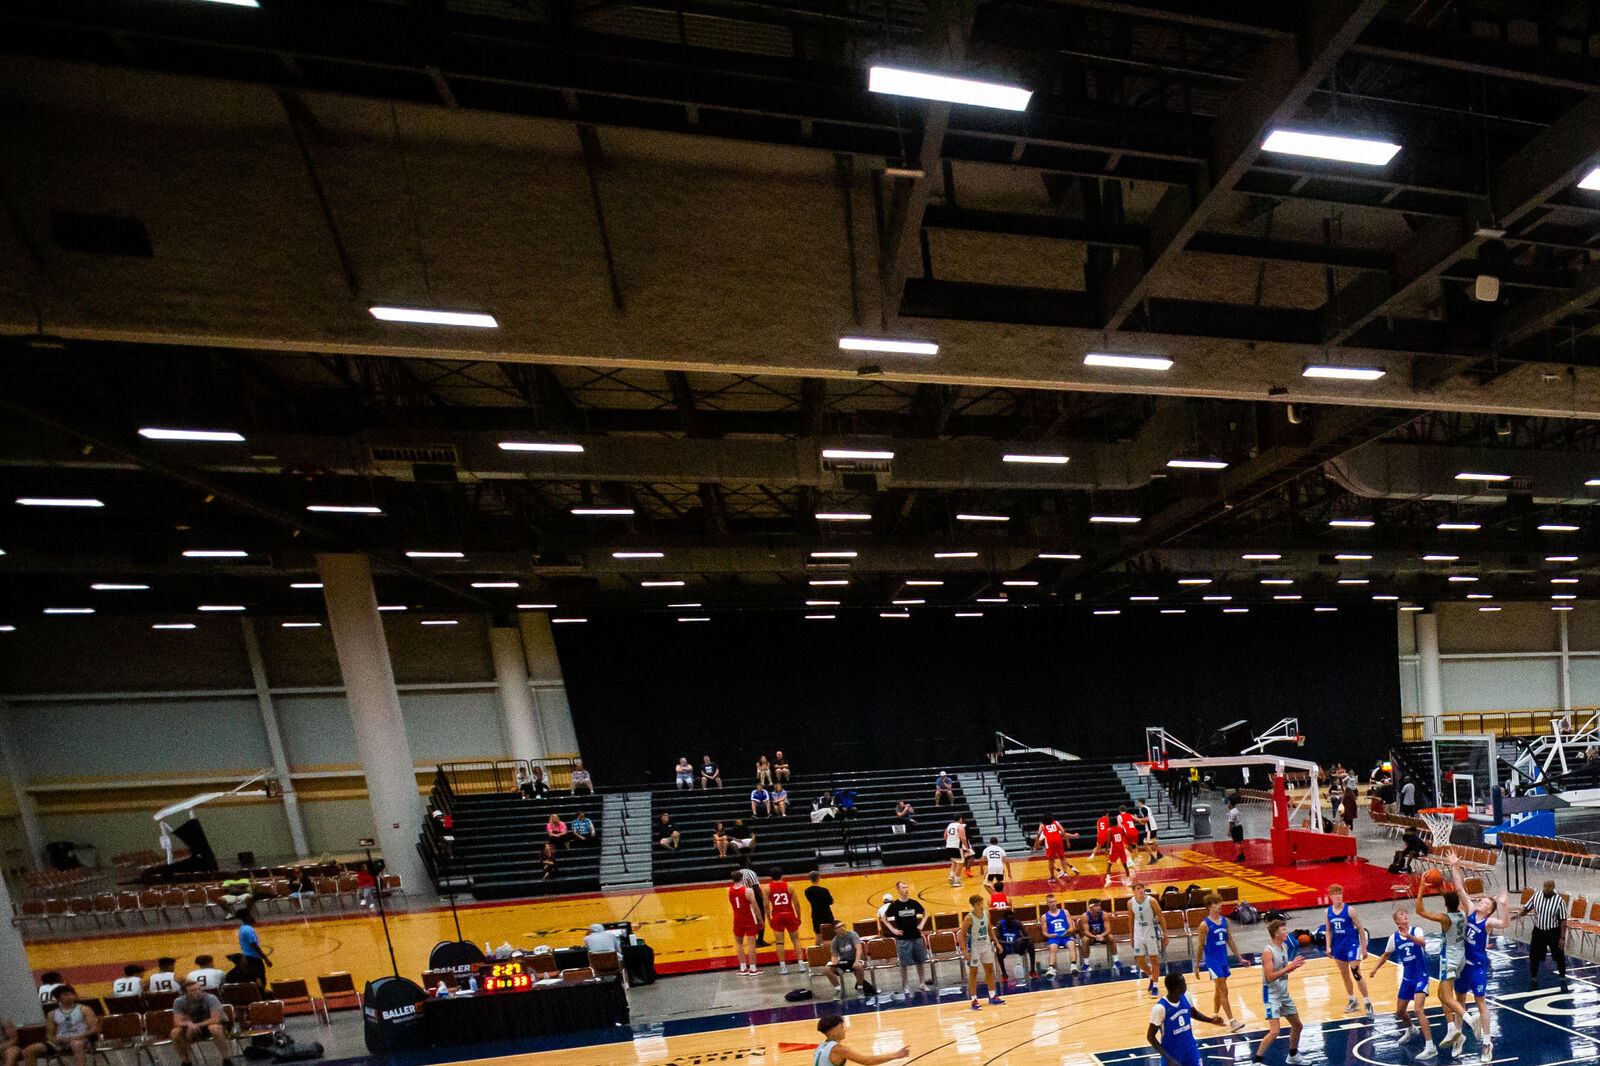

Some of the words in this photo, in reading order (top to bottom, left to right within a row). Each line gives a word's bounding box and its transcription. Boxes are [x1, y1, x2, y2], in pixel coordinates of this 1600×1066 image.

[989, 850, 1001, 859] 25
[773, 892, 790, 906] 23
[382, 1004, 416, 1020] BALLER
